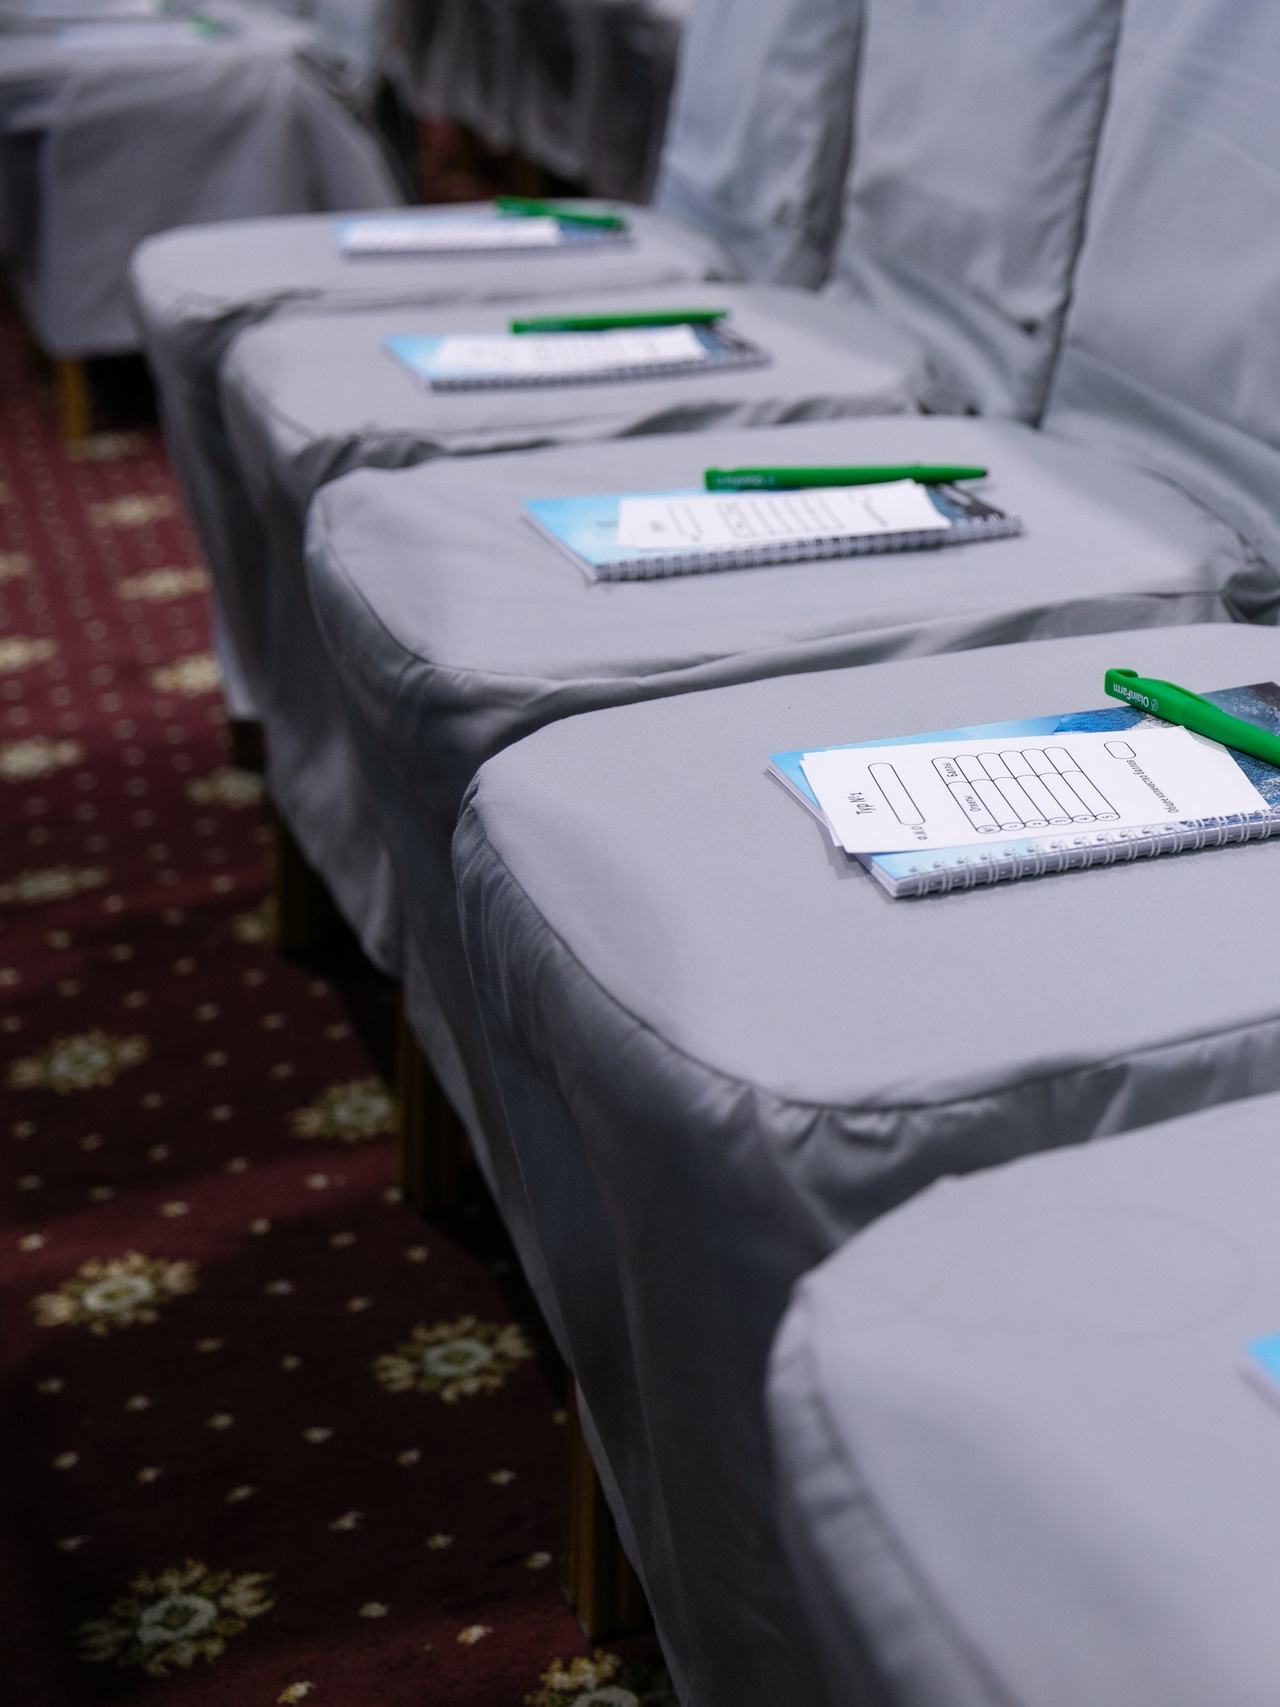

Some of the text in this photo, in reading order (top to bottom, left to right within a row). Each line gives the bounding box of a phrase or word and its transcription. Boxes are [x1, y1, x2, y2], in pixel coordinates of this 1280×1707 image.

[1113, 683, 1149, 708] OlainFarm
[943, 762, 957, 777] Баллы
[1126, 760, 1179, 813] Общее количество баллов
[856, 804, 877, 815] Тур
[965, 796, 981, 812] Ответы
